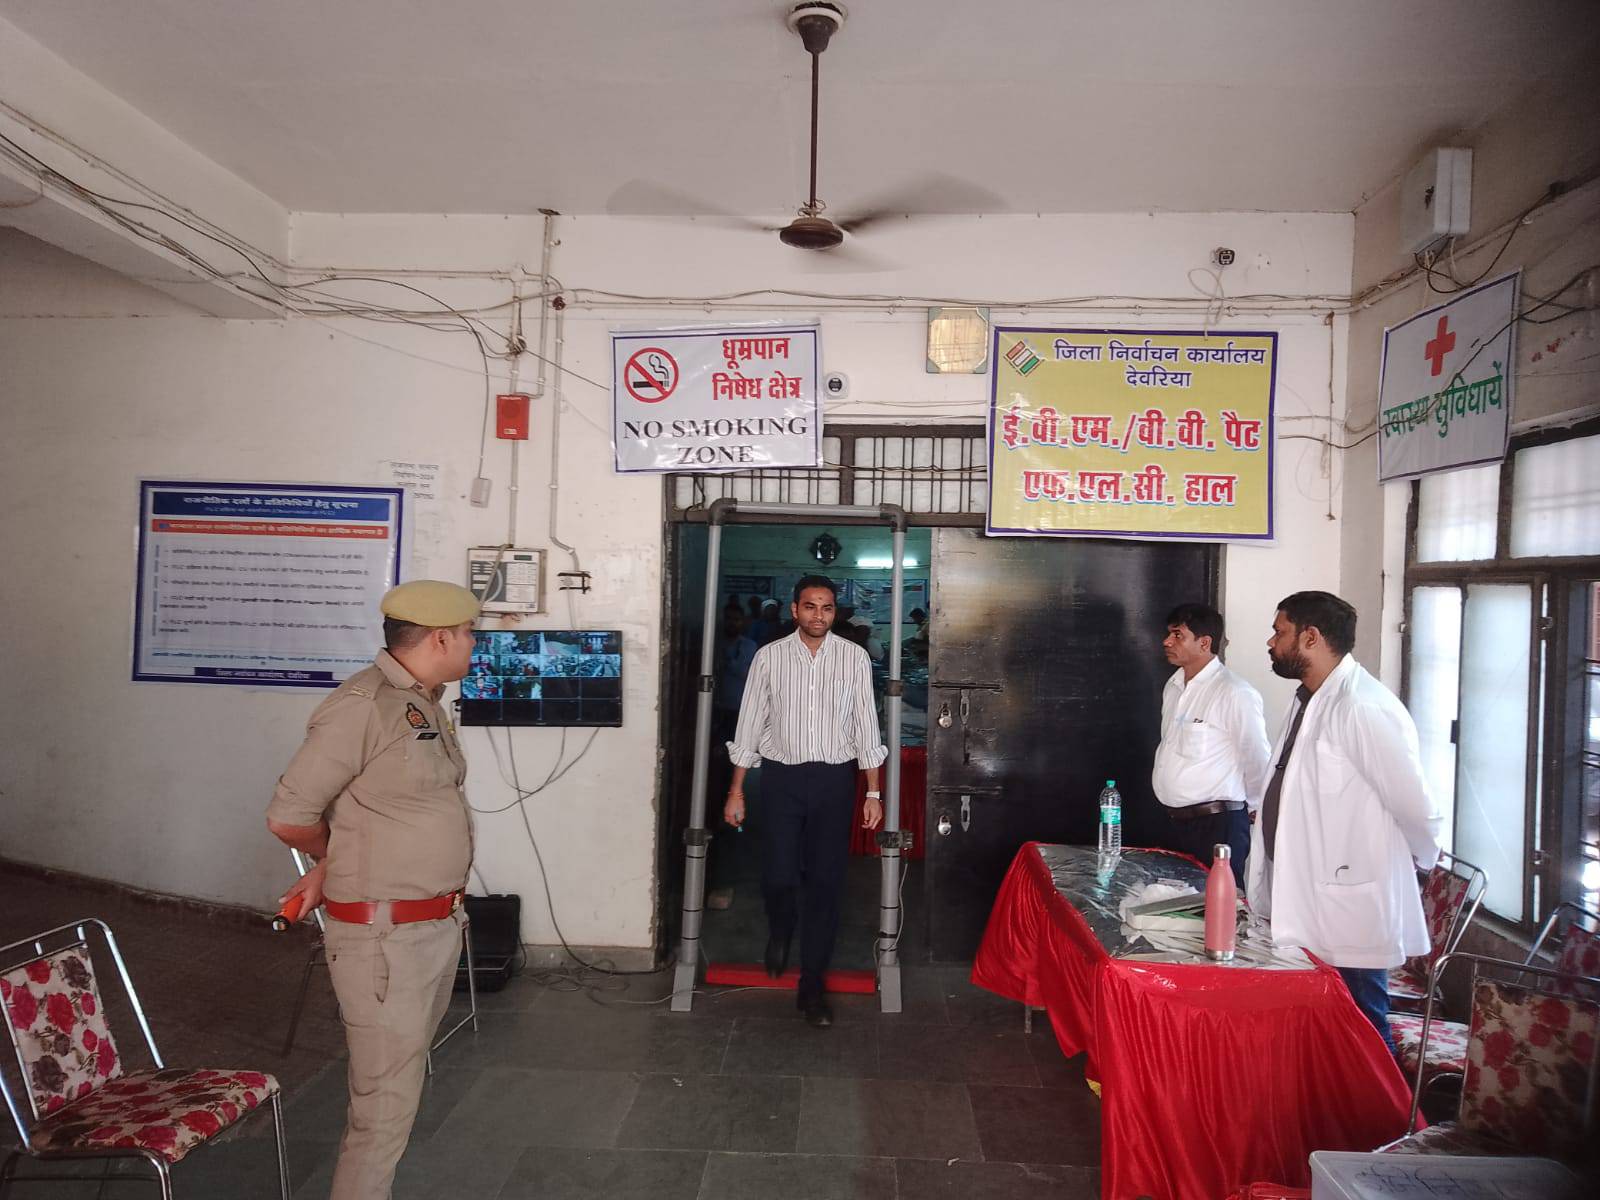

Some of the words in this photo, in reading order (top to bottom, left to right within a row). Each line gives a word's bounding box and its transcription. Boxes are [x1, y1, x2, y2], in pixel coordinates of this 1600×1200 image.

[722, 338, 791, 369] धूम्रपान
[1054, 339, 1102, 361] जिला
[1108, 340, 1180, 362] निर्वाचन
[1186, 342, 1267, 365] कार्यालय
[712, 372, 764, 401] निषेध
[768, 371, 803, 400] क्षेत्र
[1126, 365, 1192, 387] देवरिया
[623, 421, 664, 439] NO
[672, 417, 808, 439] SMOKING
[1222, 411, 1261, 449] पैट
[678, 445, 754, 465] ZONE
[1023, 466, 1174, 502] एफ.एल.सी.
[1185, 474, 1237, 503] हाल
